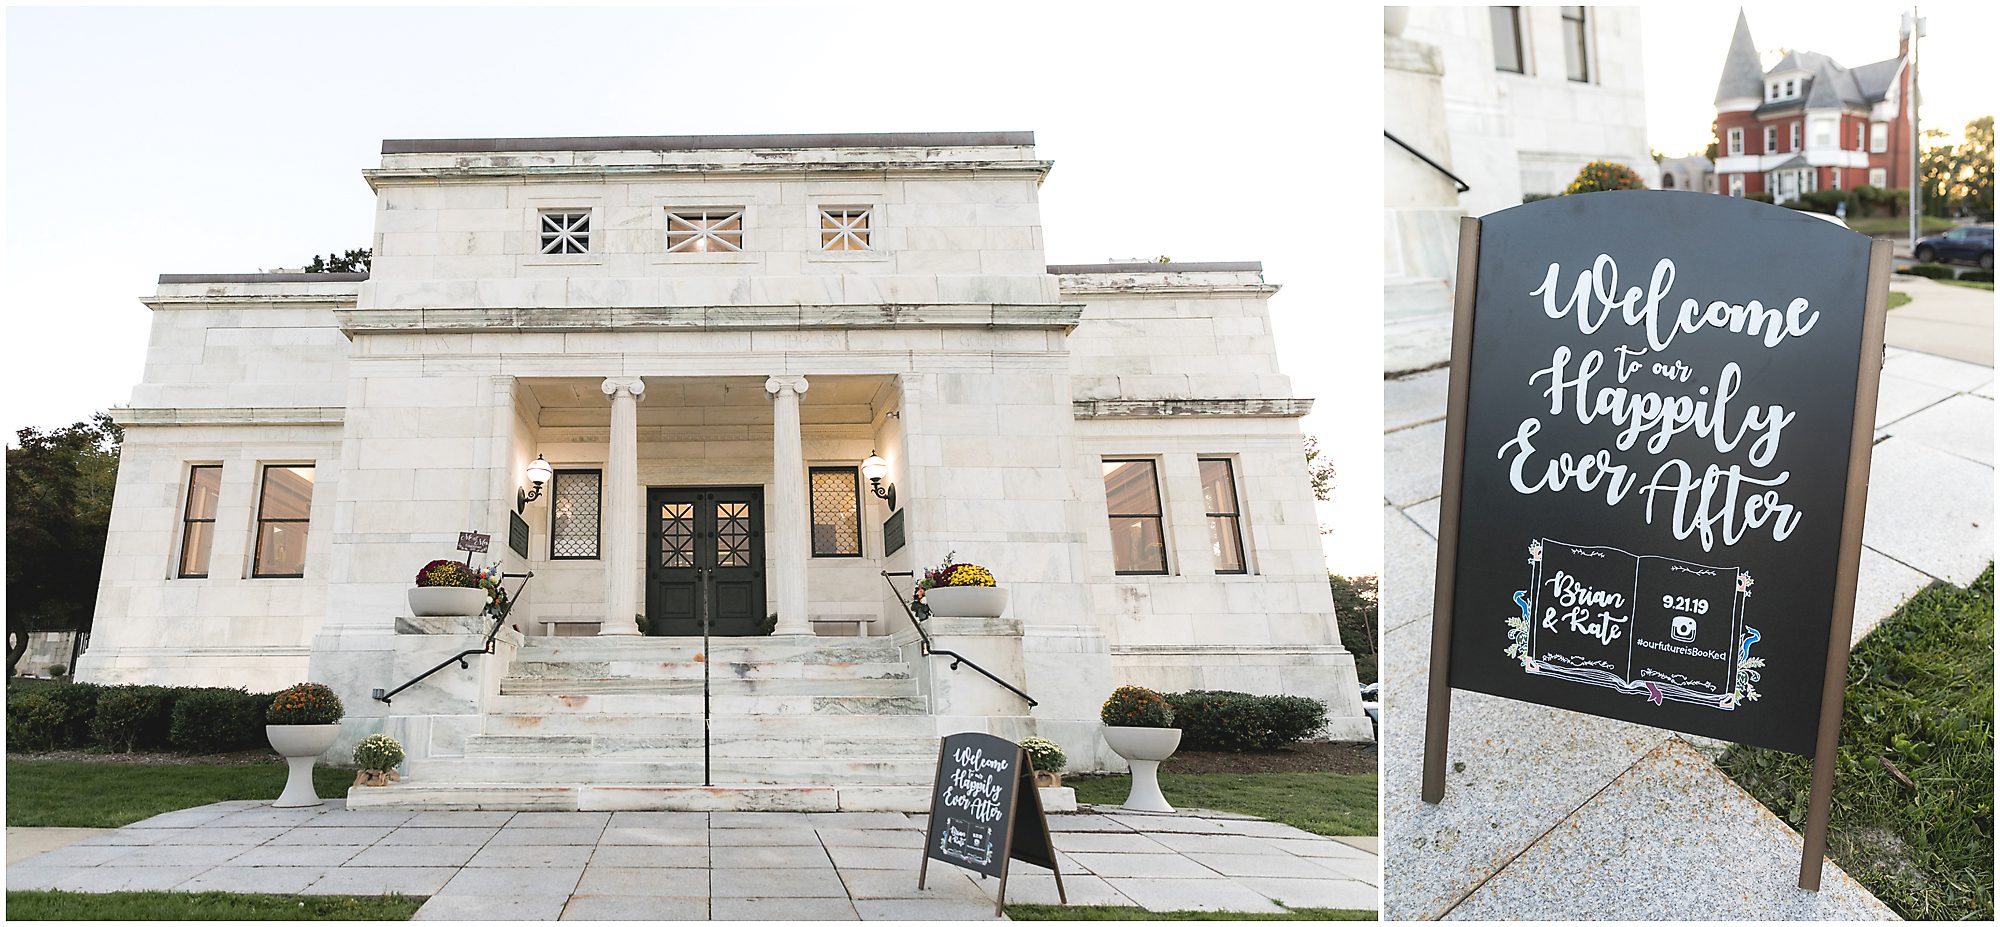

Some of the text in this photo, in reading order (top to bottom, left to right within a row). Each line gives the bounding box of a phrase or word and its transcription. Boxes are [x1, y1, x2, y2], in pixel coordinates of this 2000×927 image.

[1530, 254, 1819, 352] Welcome
[1614, 345, 1692, 383] to our
[1529, 346, 1796, 467] Happily
[1498, 418, 1802, 552] Ever After
[1545, 571, 1625, 609] Brian
[1662, 594, 1709, 615] 9.21.19
[1542, 606, 1629, 647] & Kate
[953, 747, 1008, 772] Welcome
[943, 786, 1002, 822] Ever After
[951, 769, 1002, 801] Happily
